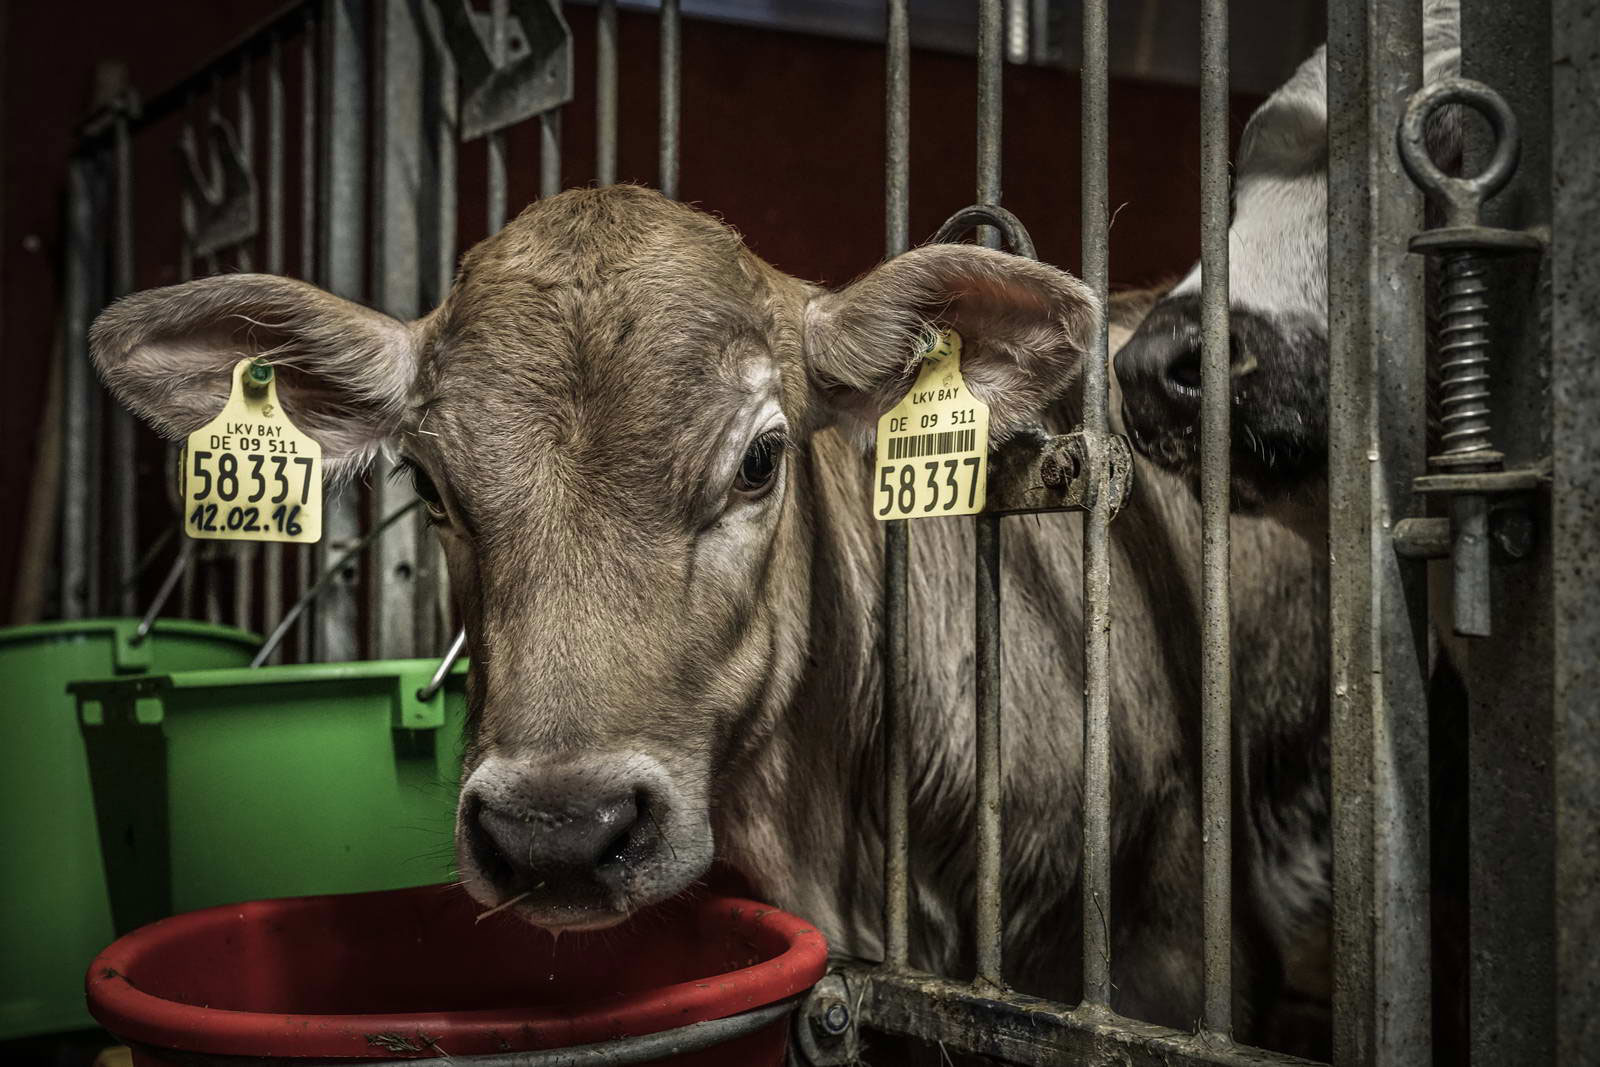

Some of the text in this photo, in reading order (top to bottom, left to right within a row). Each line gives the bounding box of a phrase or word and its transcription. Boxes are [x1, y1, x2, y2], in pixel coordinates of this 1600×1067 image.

[912, 387, 960, 405] LKV BAY
[890, 408, 976, 433] DE 09 511
[226, 423, 282, 438] LKV BAY
[210, 435, 299, 454] DE 09 511
[190, 503, 303, 537] 12.02.16
